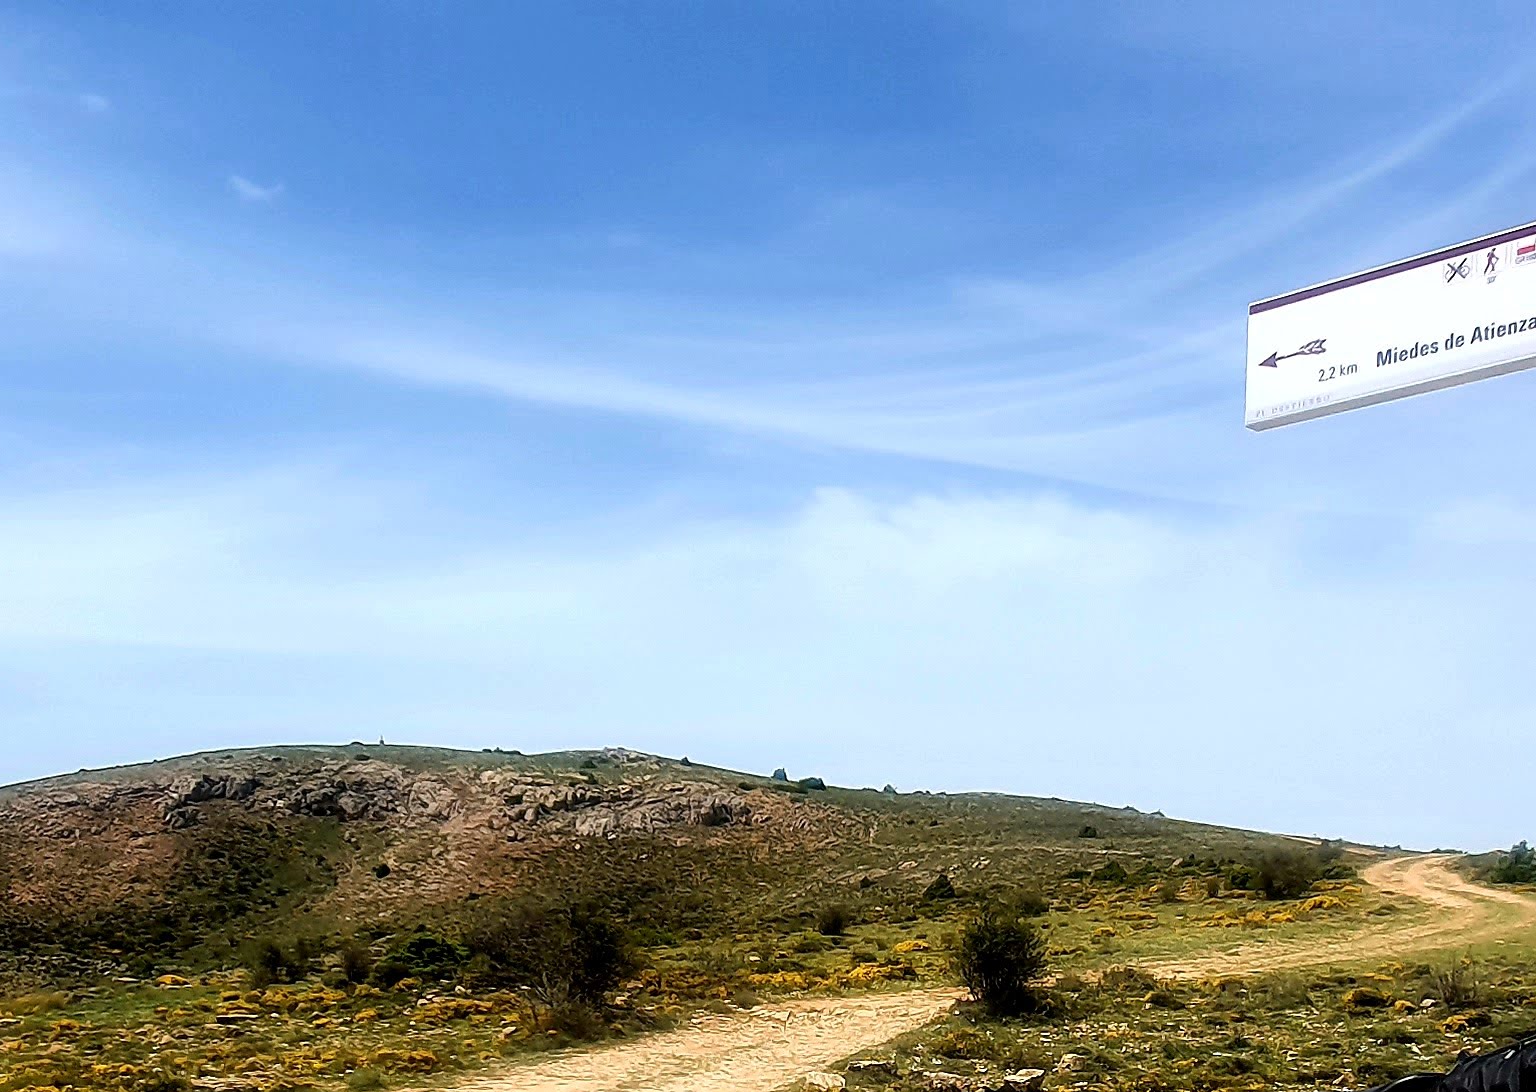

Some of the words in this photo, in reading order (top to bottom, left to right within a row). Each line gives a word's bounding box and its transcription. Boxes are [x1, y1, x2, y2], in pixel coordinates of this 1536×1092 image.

[1376, 341, 1439, 368] Miedes
[1444, 332, 1465, 351] de
[1339, 363, 1358, 377] km
